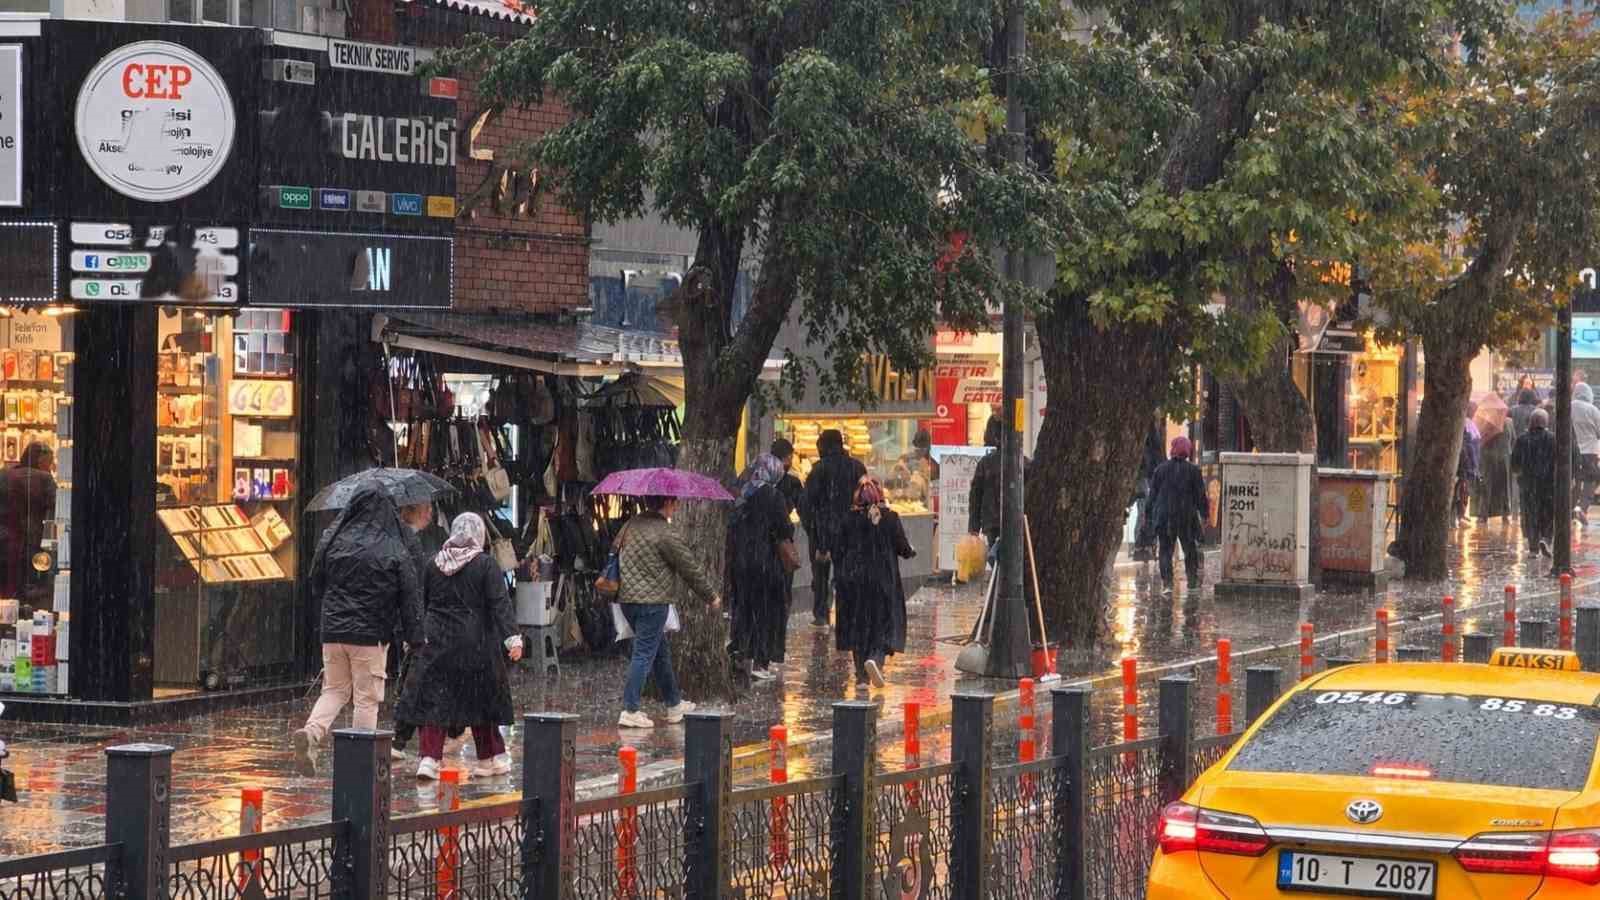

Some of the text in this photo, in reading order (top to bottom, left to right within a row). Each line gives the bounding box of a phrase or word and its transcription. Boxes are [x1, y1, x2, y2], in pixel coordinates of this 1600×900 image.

[122, 63, 192, 100] CEP
[282, 192, 309, 204] oppo
[1230, 499, 1256, 511] 2011
[1314, 691, 1408, 705] 0546
[1480, 698, 1526, 713] 85
[1296, 857, 1320, 882] 10
[1341, 860, 1354, 885] T
[1375, 863, 1431, 891] 2087
